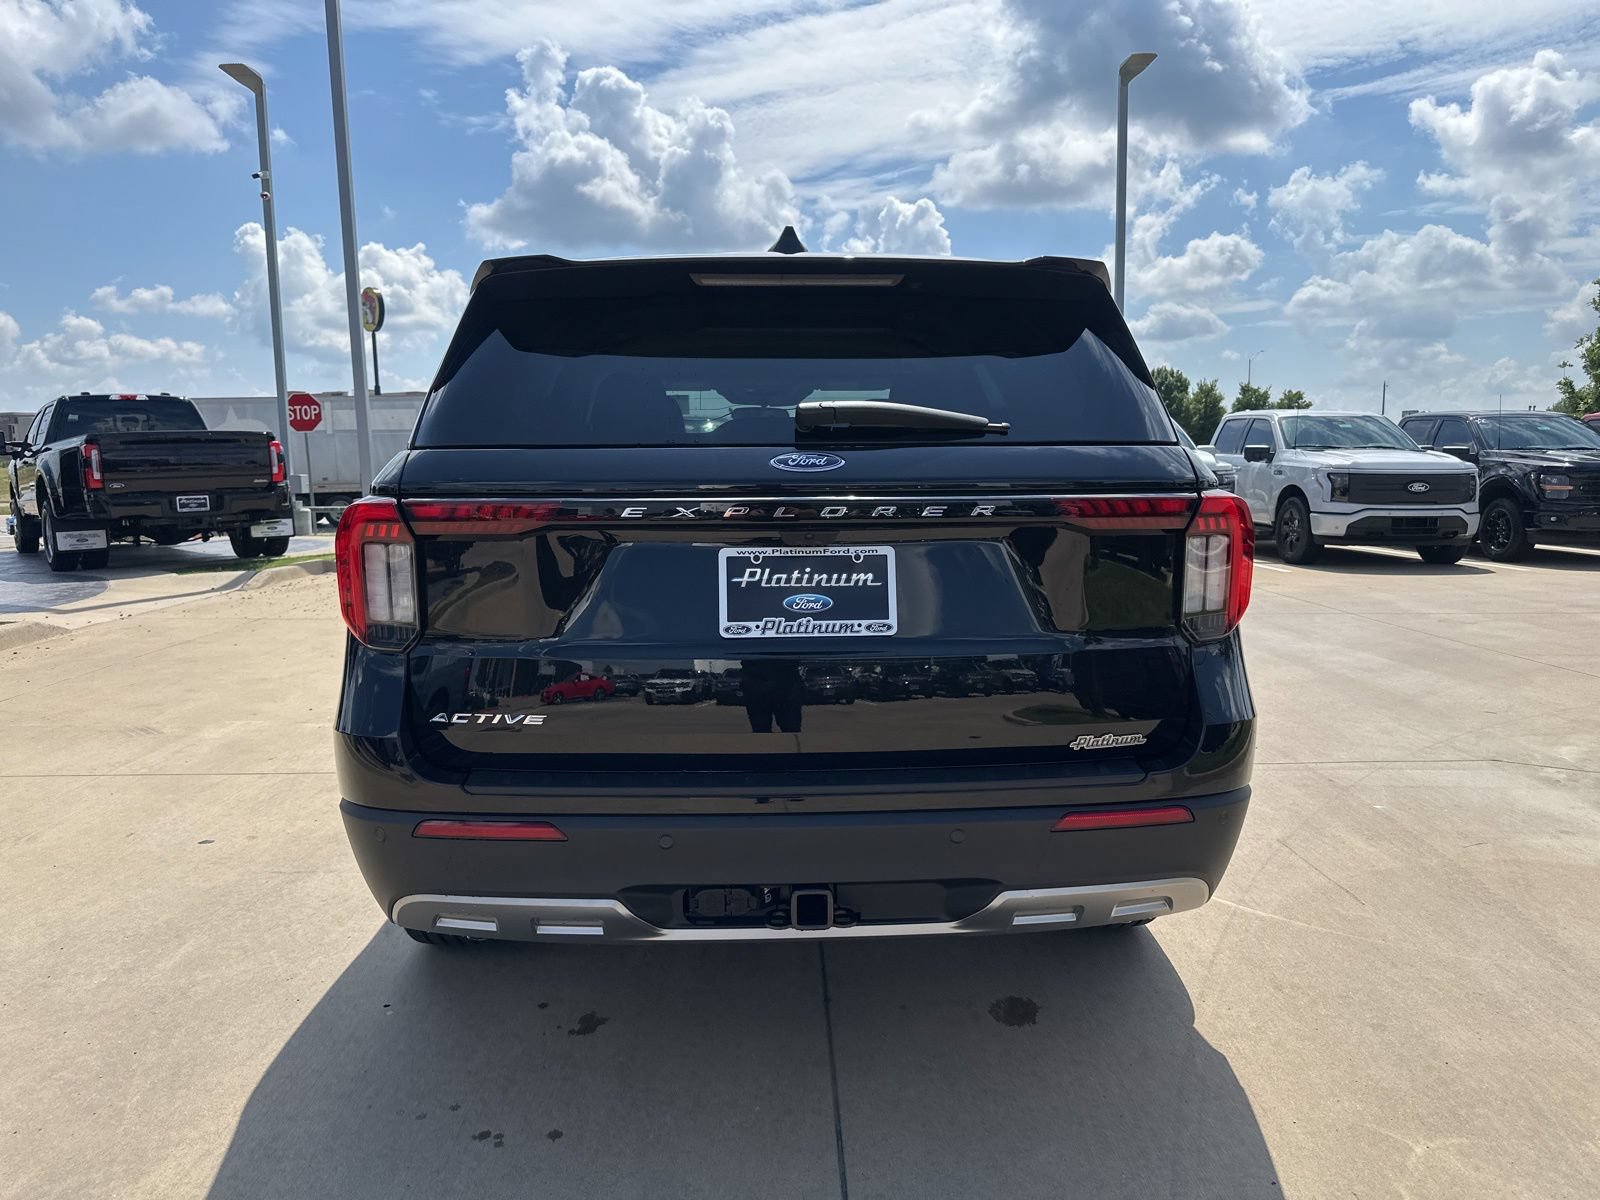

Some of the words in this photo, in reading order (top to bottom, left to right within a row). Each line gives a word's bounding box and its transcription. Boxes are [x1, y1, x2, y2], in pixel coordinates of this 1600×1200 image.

[288, 405, 320, 420] STOP
[788, 454, 828, 466] Ford
[620, 505, 996, 519] EXPLORER
[731, 567, 882, 588] Platinum
[792, 597, 823, 610] Ford
[756, 618, 862, 635] Platinum
[429, 712, 548, 725] ACTIVE
[1069, 733, 1147, 750] Platinum
